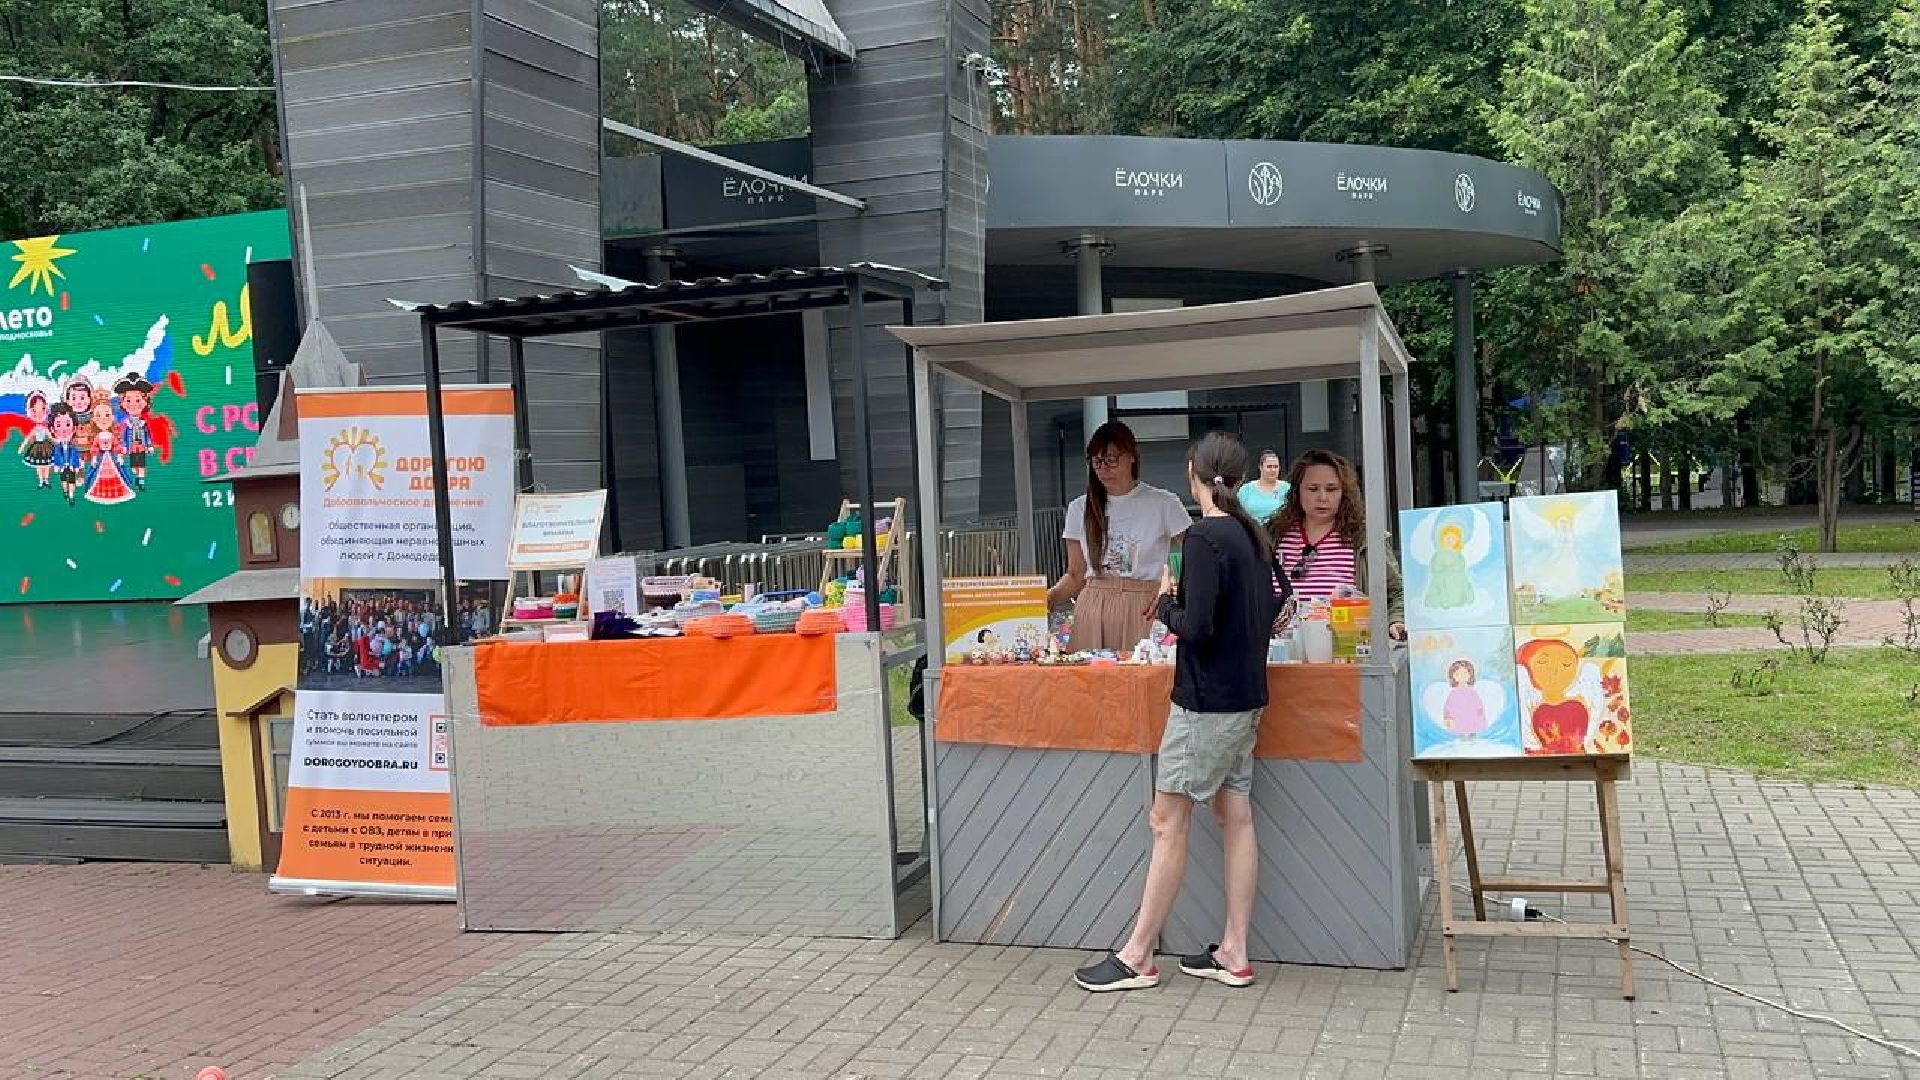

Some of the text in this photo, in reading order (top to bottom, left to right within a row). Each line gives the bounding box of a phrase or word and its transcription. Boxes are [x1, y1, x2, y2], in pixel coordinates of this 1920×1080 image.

[1115, 167, 1183, 188] ЁЛОЧКИ
[1337, 171, 1388, 192] ЁЛОЧКИ
[1134, 188, 1165, 196] ПАРК
[747, 194, 785, 205] ПАРК
[196, 405, 217, 434] С
[198, 447, 217, 477] В
[396, 456, 485, 472] ДОРГОЮ
[409, 476, 470, 491] ДОРА
[201, 489, 222, 507] 12
[328, 520, 400, 531] Общественная
[320, 534, 394, 545] объединяющая
[340, 550, 374, 560] людей
[377, 552, 385, 560] г.
[307, 709, 418, 724] Стать волонтером
[306, 726, 418, 737] и помочь посильной
[311, 809, 318, 818] С
[320, 809, 341, 820] 2013
[343, 812, 352, 820] г.
[353, 812, 370, 820] мы
[372, 812, 426, 822] помогаем
[302, 824, 310, 832] с
[311, 825, 349, 835] детьми
[351, 826, 358, 835] с
[359, 825, 385, 836] ОВЗ,
[386, 827, 420, 838] детям
[422, 830, 430, 838] в
[308, 839, 347, 848] семьям
[348, 842, 356, 850] в
[358, 842, 403, 852] трудной
[359, 857, 413, 867] ситуации.
